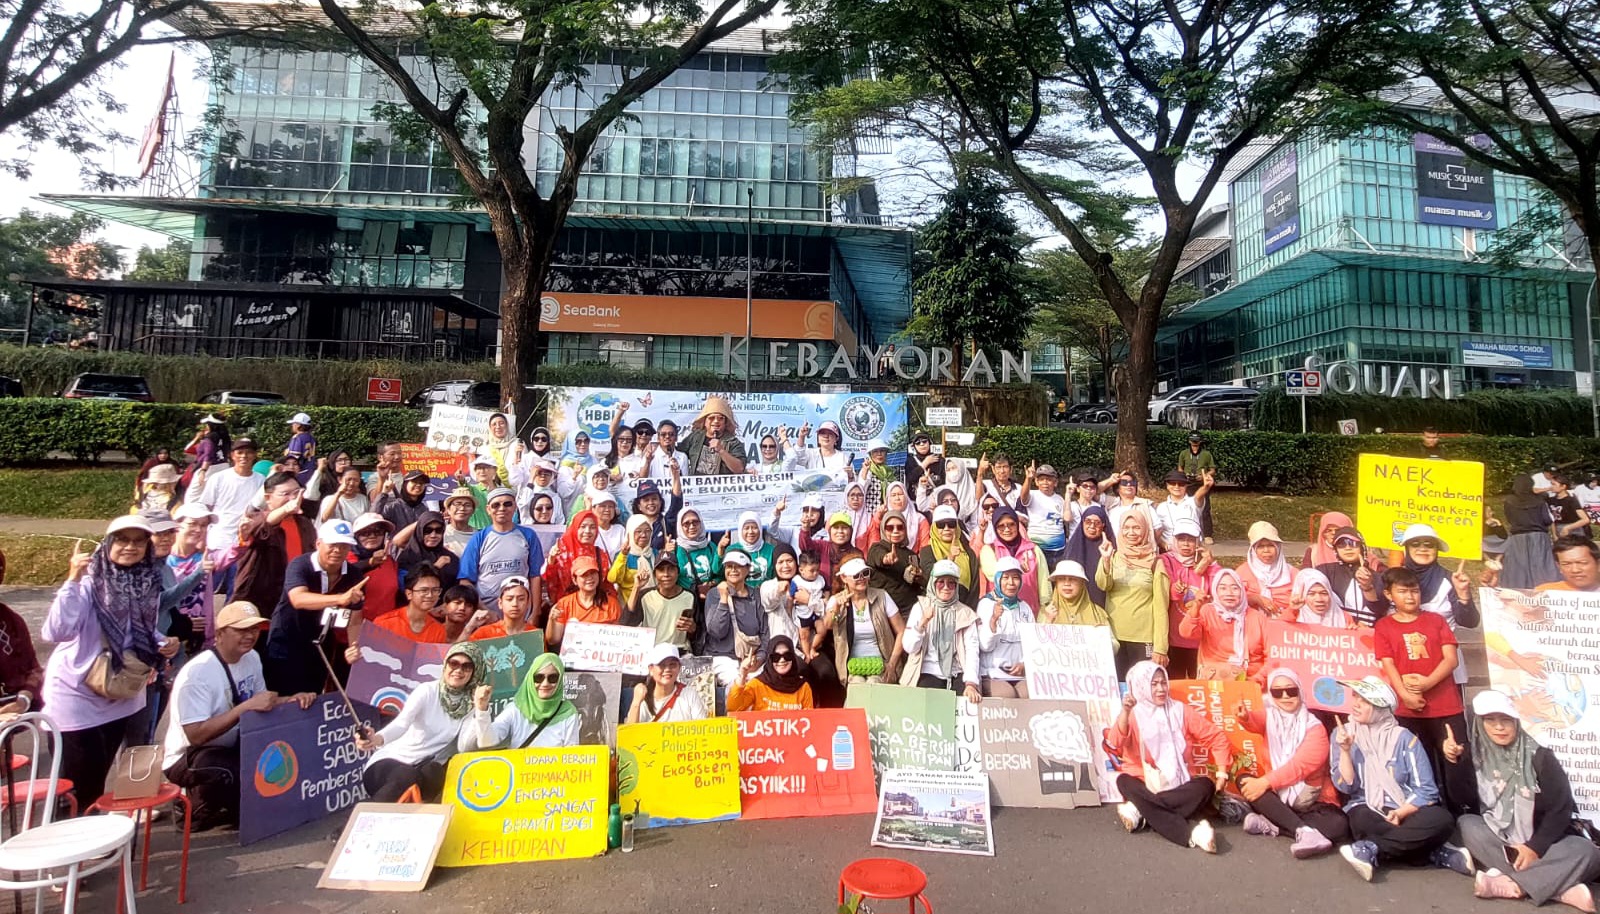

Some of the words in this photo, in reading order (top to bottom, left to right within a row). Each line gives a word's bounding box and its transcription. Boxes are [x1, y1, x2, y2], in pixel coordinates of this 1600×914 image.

[1428, 171, 1452, 181] MUSIC
[1454, 174, 1485, 185] SQUARE
[1424, 206, 1455, 216] nuansa
[1457, 209, 1483, 218] musik
[248, 302, 273, 315] kopi
[563, 304, 621, 317] SeaBank
[233, 311, 288, 327] kenangan
[1471, 343, 1498, 351] YAMAHA
[1499, 344, 1518, 352] MUSIC
[1519, 345, 1545, 353] SCHOOL
[722, 333, 1032, 384] KEBAYORAN
[744, 403, 766, 411] HIDUP
[767, 404, 798, 412] SEDUNIA
[629, 476, 691, 489] GEAKN
[695, 475, 746, 487] BANTEN
[750, 472, 794, 483] BERSIH
[1374, 464, 1434, 485] NAEK
[698, 483, 767, 495] BUMIKU
[1417, 485, 1483, 503] Kendaraan
[598, 628, 640, 639] POLLUTION
[1283, 631, 1355, 649] LINDUNGI
[1303, 648, 1345, 664] MULAI
[1544, 661, 1590, 674] William
[1033, 671, 1120, 699] NARKOBA
[981, 706, 1018, 721] RINDU
[736, 717, 811, 739] PLASTIK?
[902, 717, 943, 737] DAN
[983, 727, 1029, 745] UDARA
[1569, 729, 1597, 742] Earth
[524, 754, 558, 766] UDARA
[561, 753, 598, 764] BERSIH
[984, 752, 1032, 771] BERSIH
[520, 769, 593, 786] TERIMAKASIH
[515, 786, 565, 804] ENGKAU
[543, 799, 598, 818] SANGAT
[560, 817, 593, 832] BAGI
[461, 838, 567, 862] KEHIDUPAN
